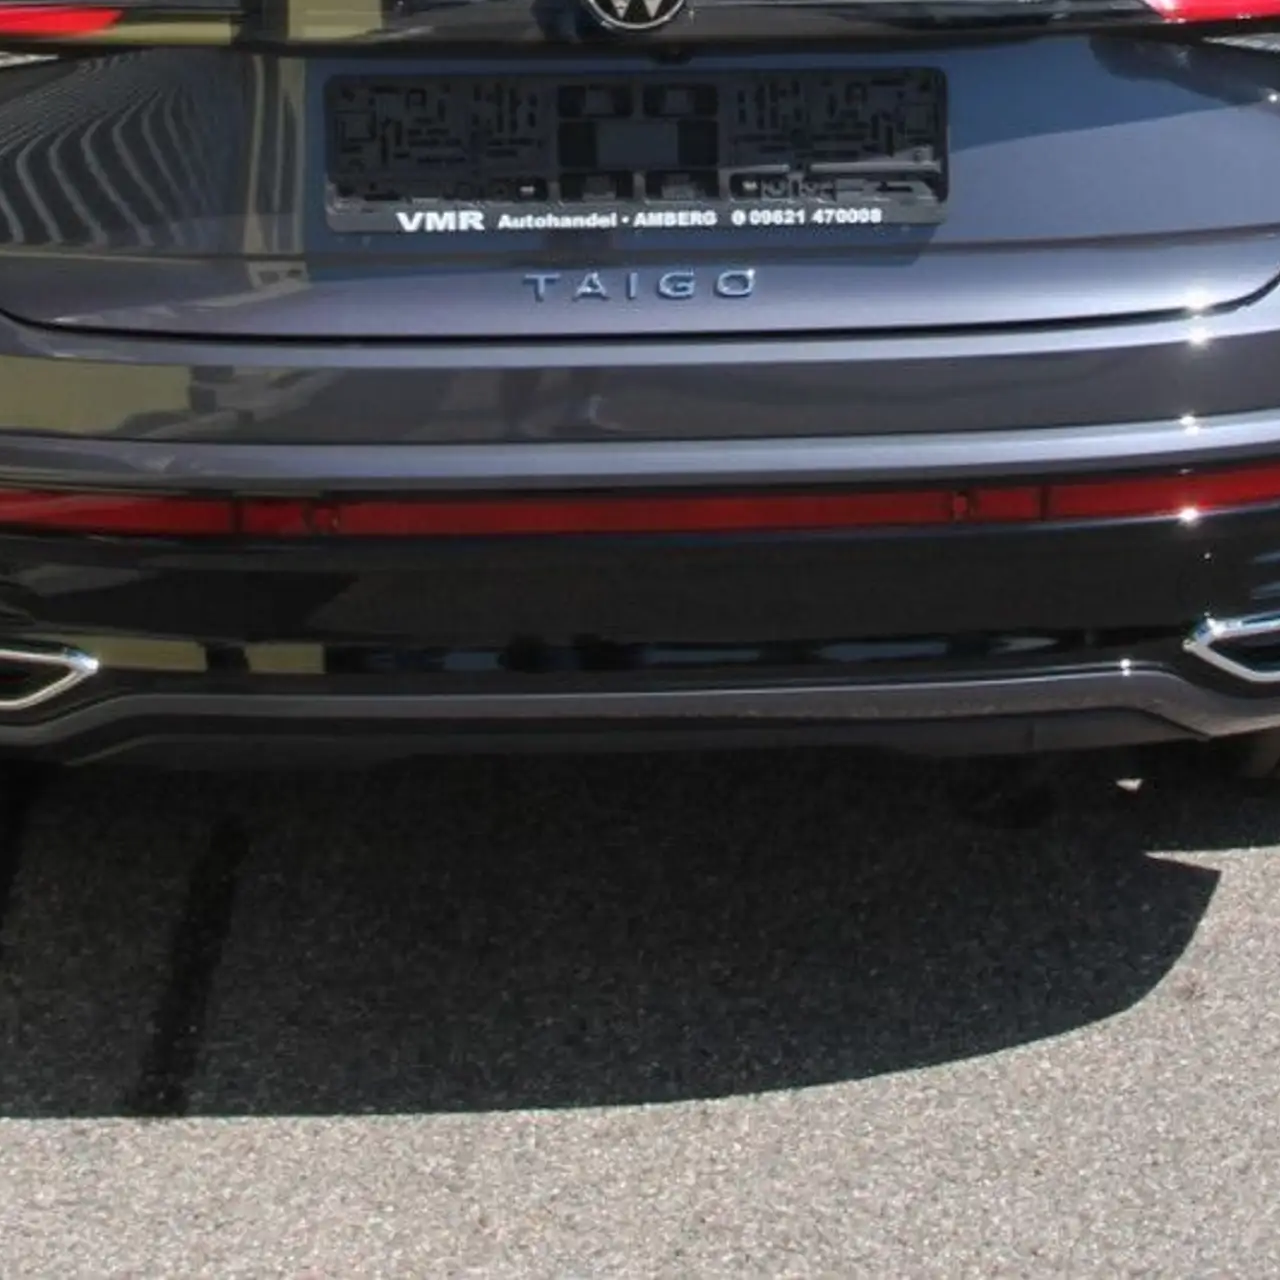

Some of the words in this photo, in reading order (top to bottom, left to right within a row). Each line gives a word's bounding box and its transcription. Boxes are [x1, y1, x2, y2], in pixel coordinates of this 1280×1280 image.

[397, 211, 485, 231] VMR
[498, 213, 617, 229] Autohandel
[633, 210, 717, 227] AMBERG
[523, 269, 756, 301] TAIGO
